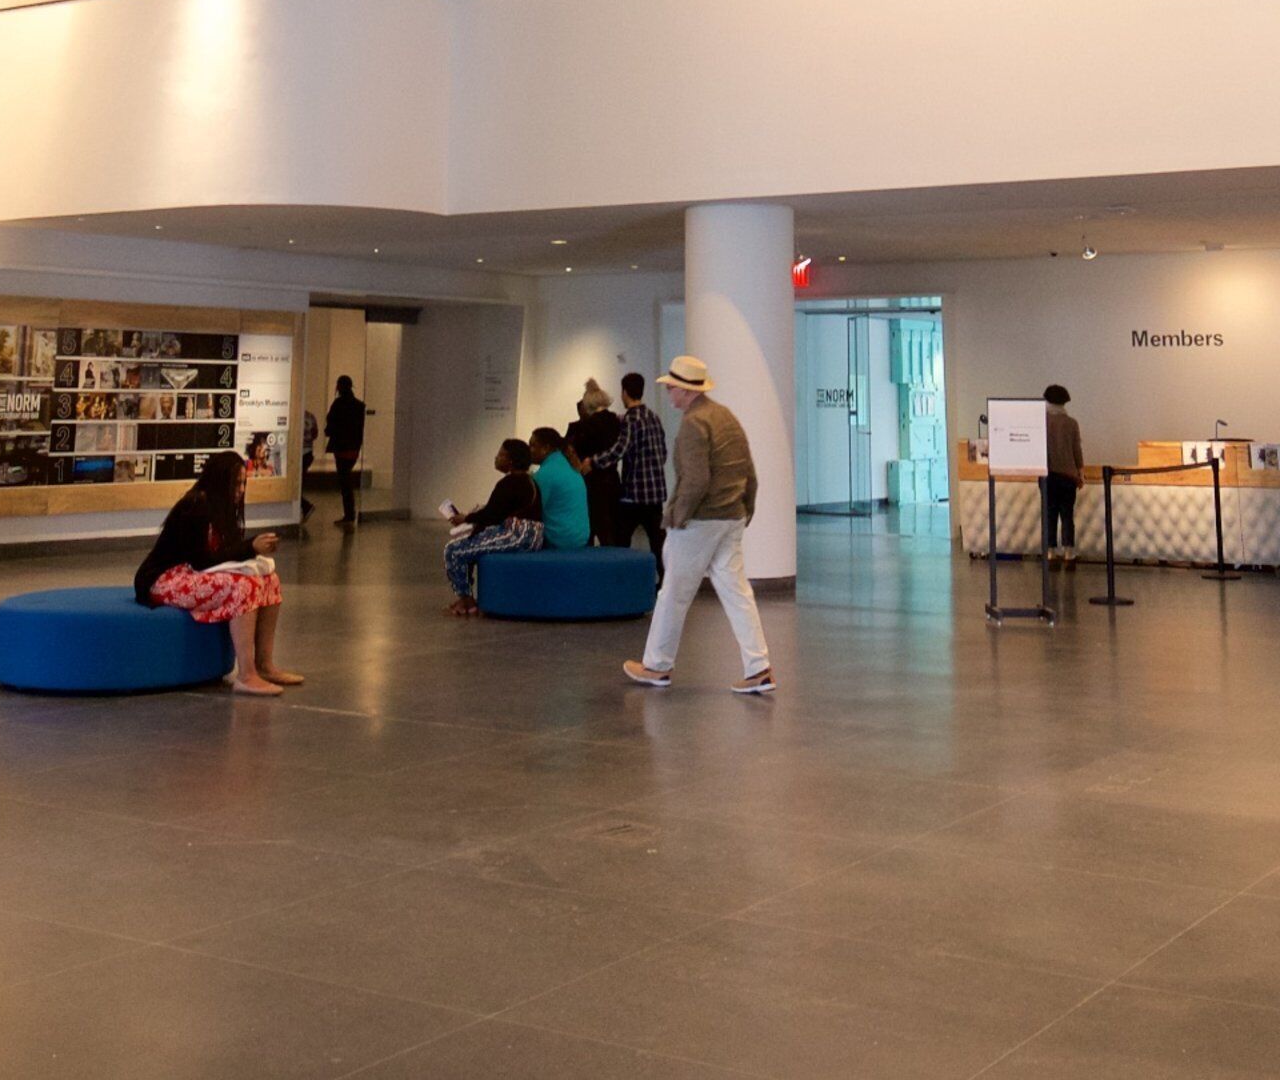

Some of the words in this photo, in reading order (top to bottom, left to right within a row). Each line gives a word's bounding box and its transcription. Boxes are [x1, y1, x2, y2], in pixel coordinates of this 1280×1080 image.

[61, 329, 77, 355] 5
[222, 337, 234, 359] 5
[1131, 329, 1224, 348] Members
[59, 362, 74, 387] 4
[220, 366, 233, 388] 4
[7, 393, 41, 412] NORM
[57, 393, 71, 419] 3
[218, 395, 232, 418] 3
[826, 388, 854, 402] NORM
[56, 426, 70, 451] 2
[218, 424, 231, 447] 2
